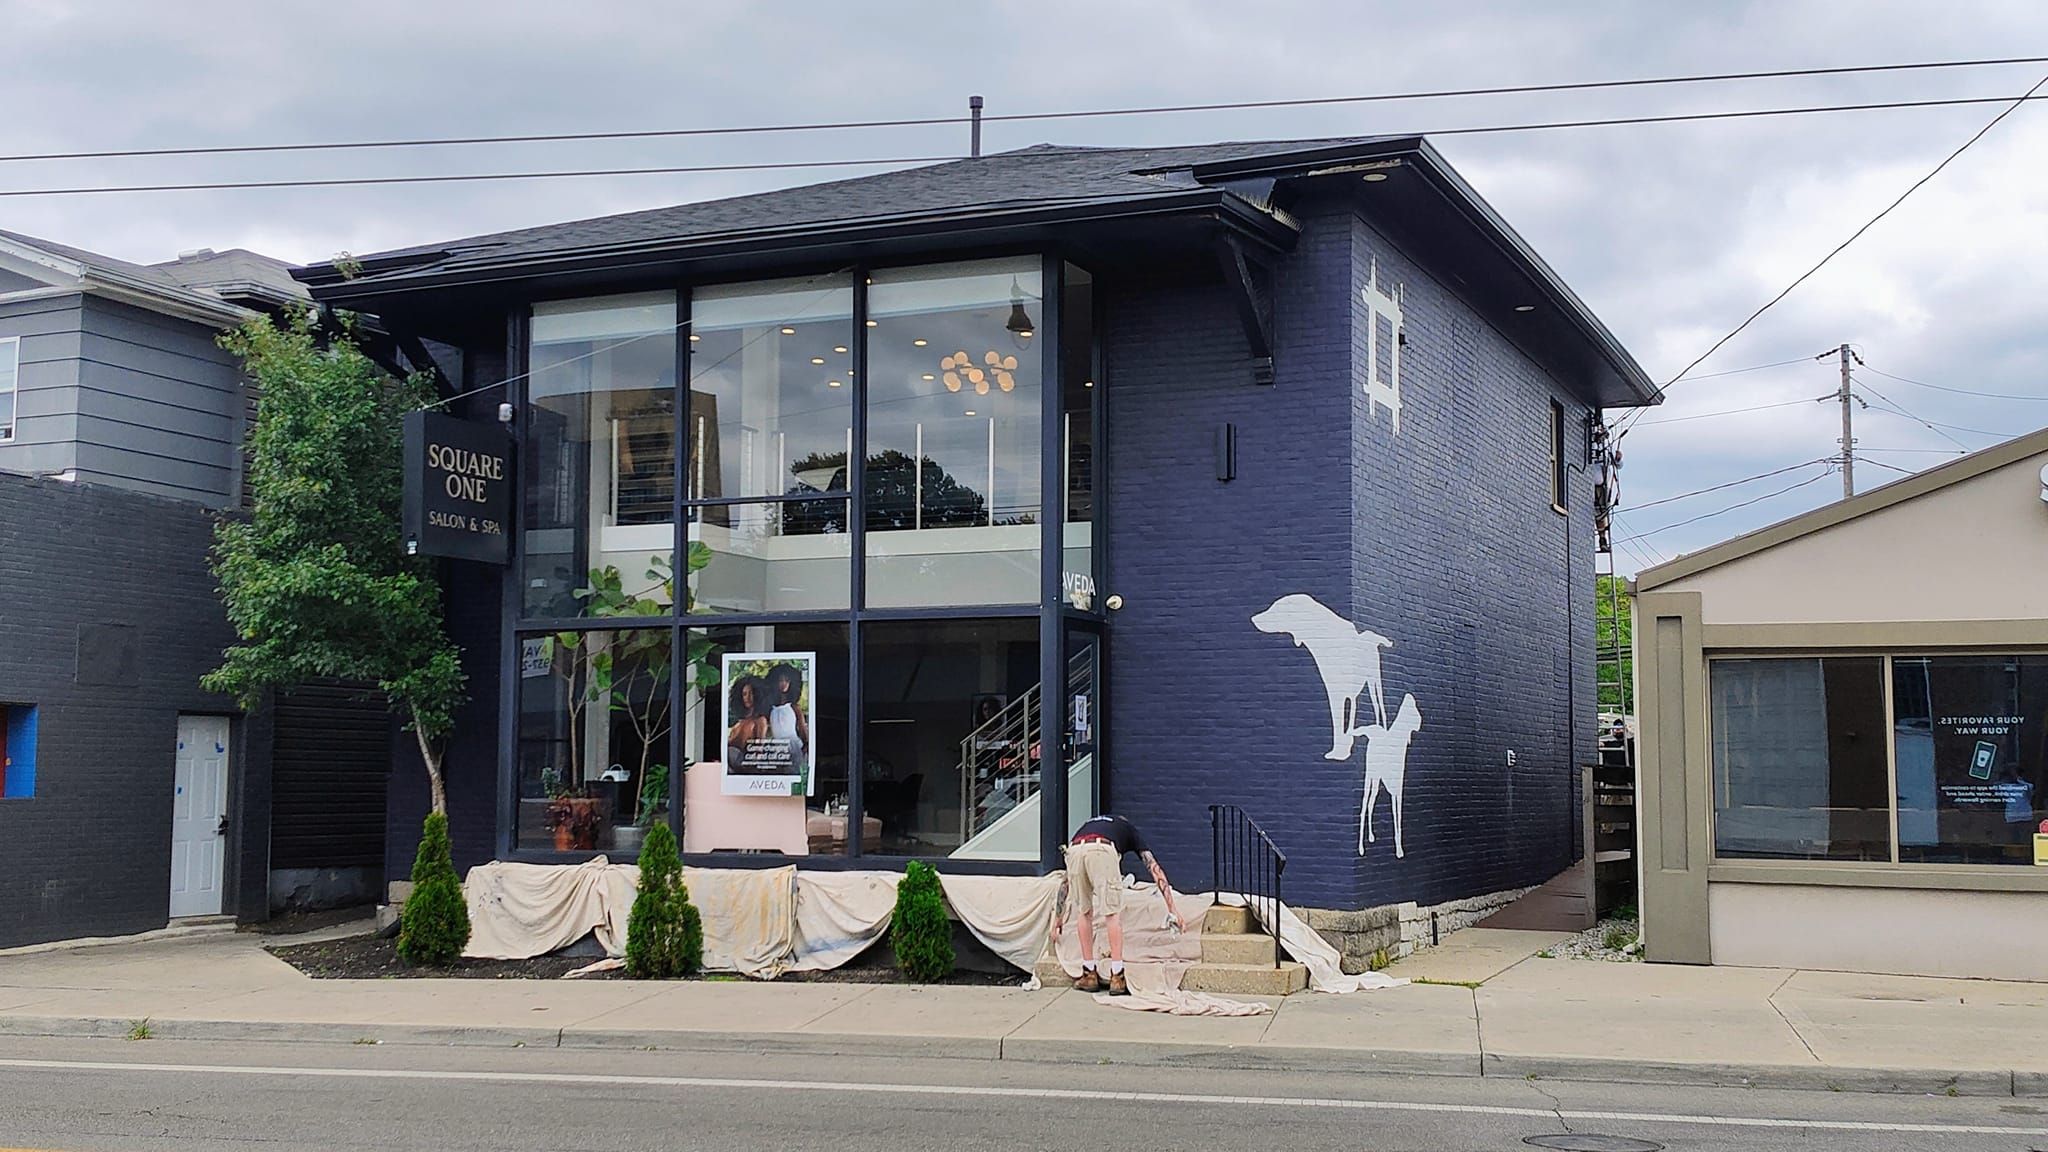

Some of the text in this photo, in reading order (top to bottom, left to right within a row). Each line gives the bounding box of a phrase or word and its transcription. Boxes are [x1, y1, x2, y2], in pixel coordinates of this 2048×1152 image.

[428, 444, 504, 480] SQUARE
[446, 474, 487, 503] ONE
[429, 510, 502, 535] SALON & SPA
[750, 780, 786, 790] AVEDA
